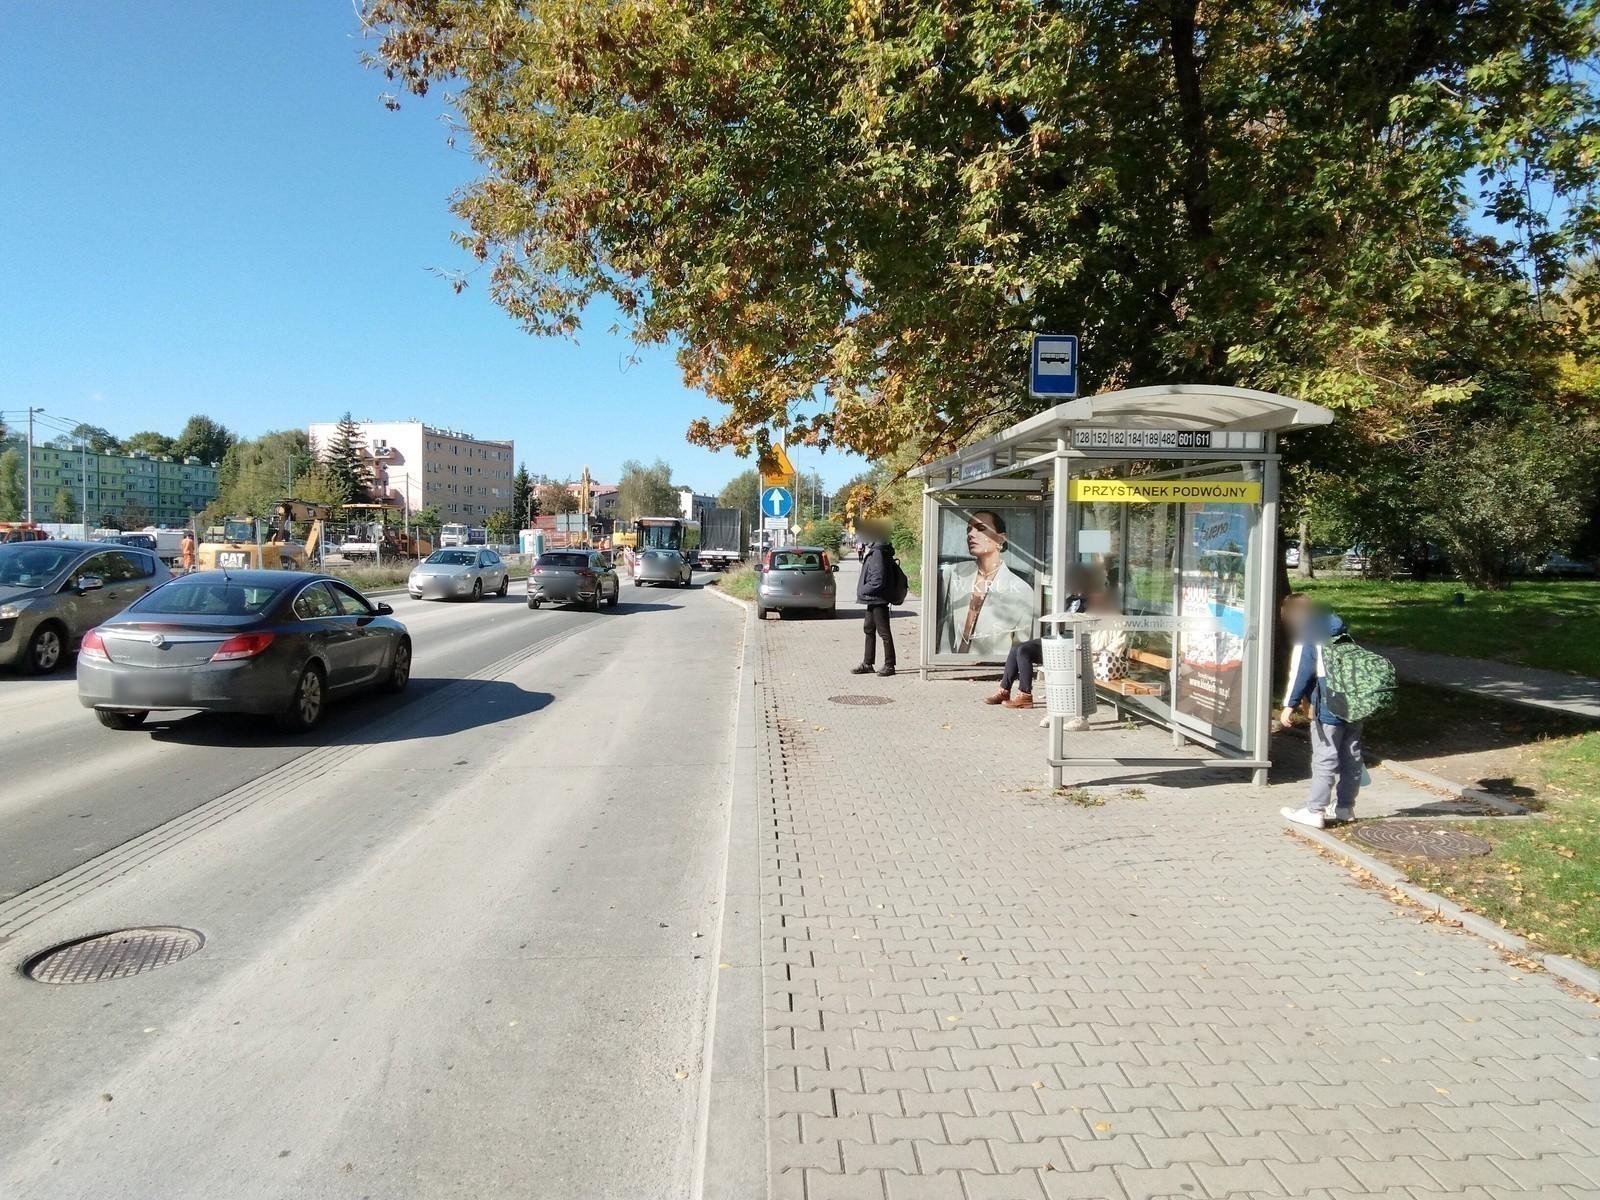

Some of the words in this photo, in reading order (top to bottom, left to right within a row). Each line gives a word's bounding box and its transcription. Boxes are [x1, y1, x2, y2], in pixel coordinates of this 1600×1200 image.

[1076, 432, 1090, 444] 128
[1093, 432, 1107, 444] 152
[1110, 432, 1124, 444] 182
[1128, 433, 1142, 444] 184
[1145, 433, 1159, 445] 189
[1161, 433, 1176, 445] 482
[1179, 433, 1193, 446] 601
[1196, 434, 1210, 446] 611
[1083, 485, 1169, 497] PRZYSTANEK
[1173, 485, 1247, 498] PODWÓJNY
[220, 552, 245, 567] CAT
